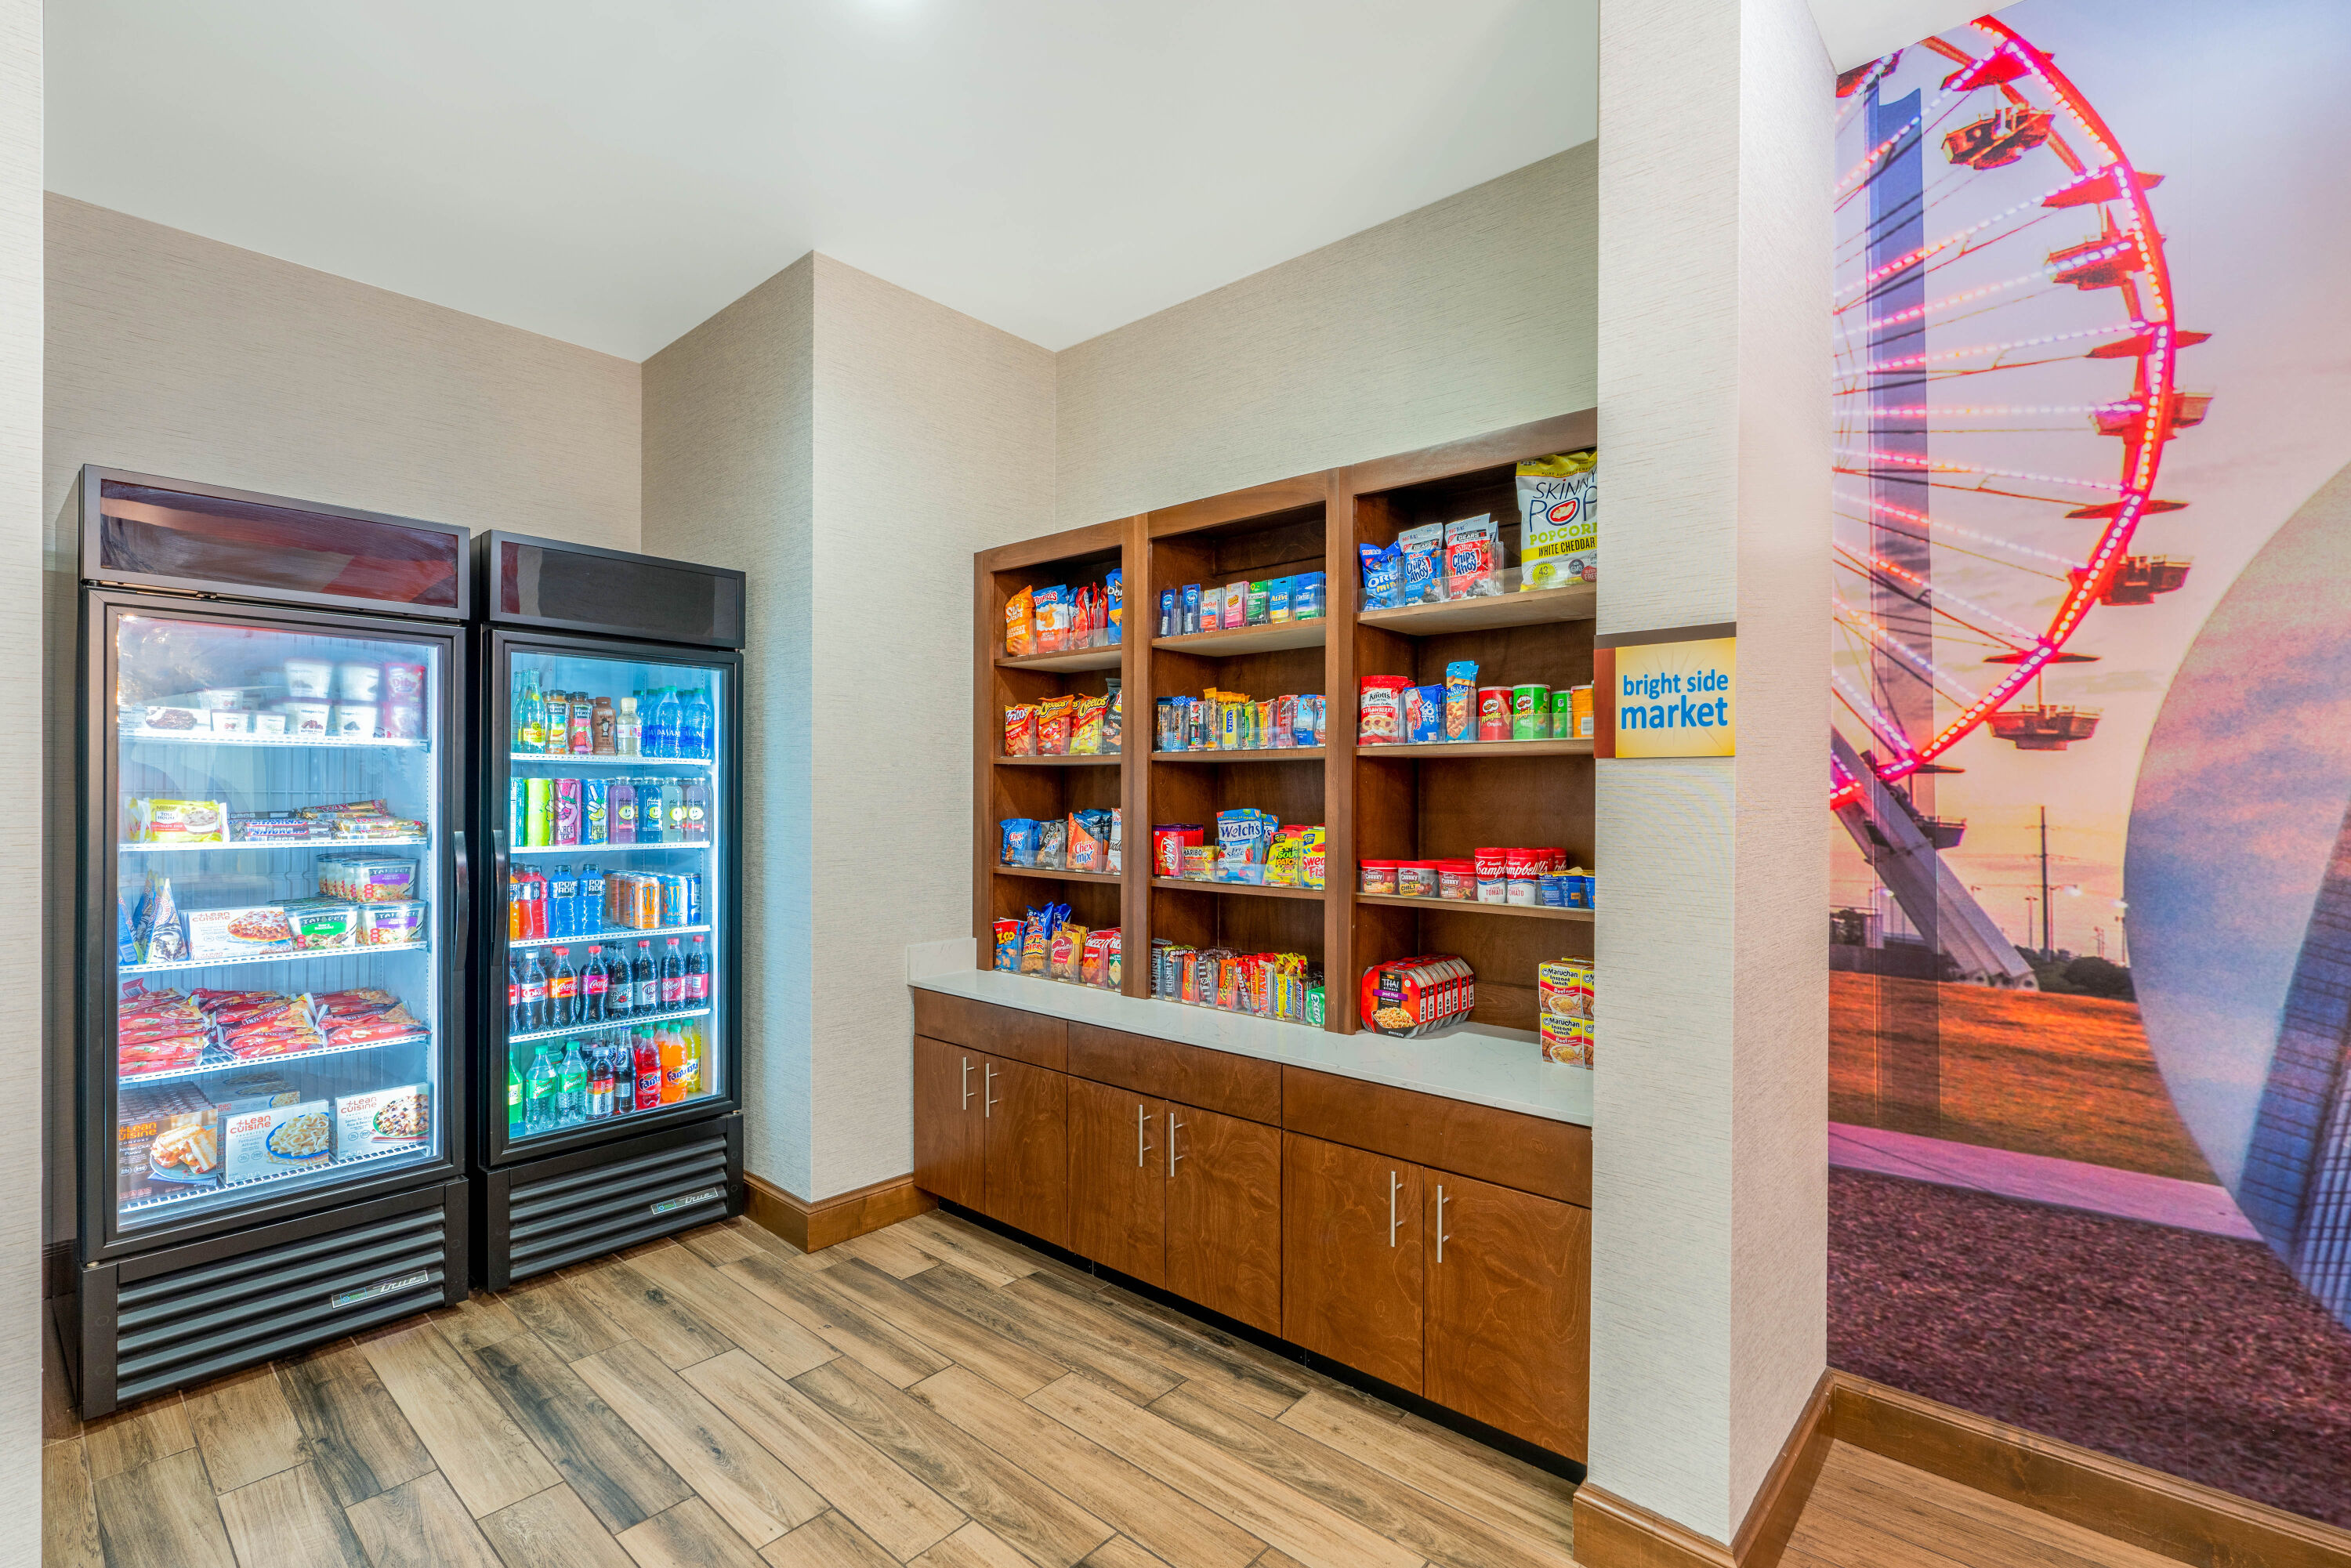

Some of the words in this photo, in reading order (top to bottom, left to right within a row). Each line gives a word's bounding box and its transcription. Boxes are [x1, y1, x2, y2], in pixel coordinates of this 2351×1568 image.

[1533, 466, 1597, 500] SKINNY
[1454, 544, 1473, 553] Mini
[1538, 541, 1558, 557] WHITE
[1560, 537, 1596, 555] CHEDDAR
[1406, 557, 1426, 576] Chips
[1452, 552, 1475, 569] Chips
[1538, 566, 1549, 576] 43
[1367, 573, 1398, 588] ORE
[1623, 672, 1681, 700] bright
[1686, 668, 1729, 693] side
[1369, 691, 1391, 702] Knott's
[1515, 708, 1536, 724] Pringles
[1621, 694, 1728, 730] market
[1481, 712, 1502, 726] Pringles
[1009, 831, 1024, 840] Chex
[1219, 823, 1260, 838] Welch's
[1074, 841, 1095, 853] Chex
[1278, 849, 1298, 858] SOUR
[1077, 851, 1092, 864] mix
[997, 931, 1015, 945] ZOO
[1023, 933, 1043, 946] HOT
[1548, 968, 1578, 978] Maruchan
[1382, 978, 1399, 988] THAI
[1259, 969, 1269, 1013] PAYDAY
[1549, 1017, 1580, 1028] Maruchan
[353, 1096, 376, 1106] Lean
[245, 1115, 271, 1125] Lean
[127, 1122, 157, 1133] Lean
